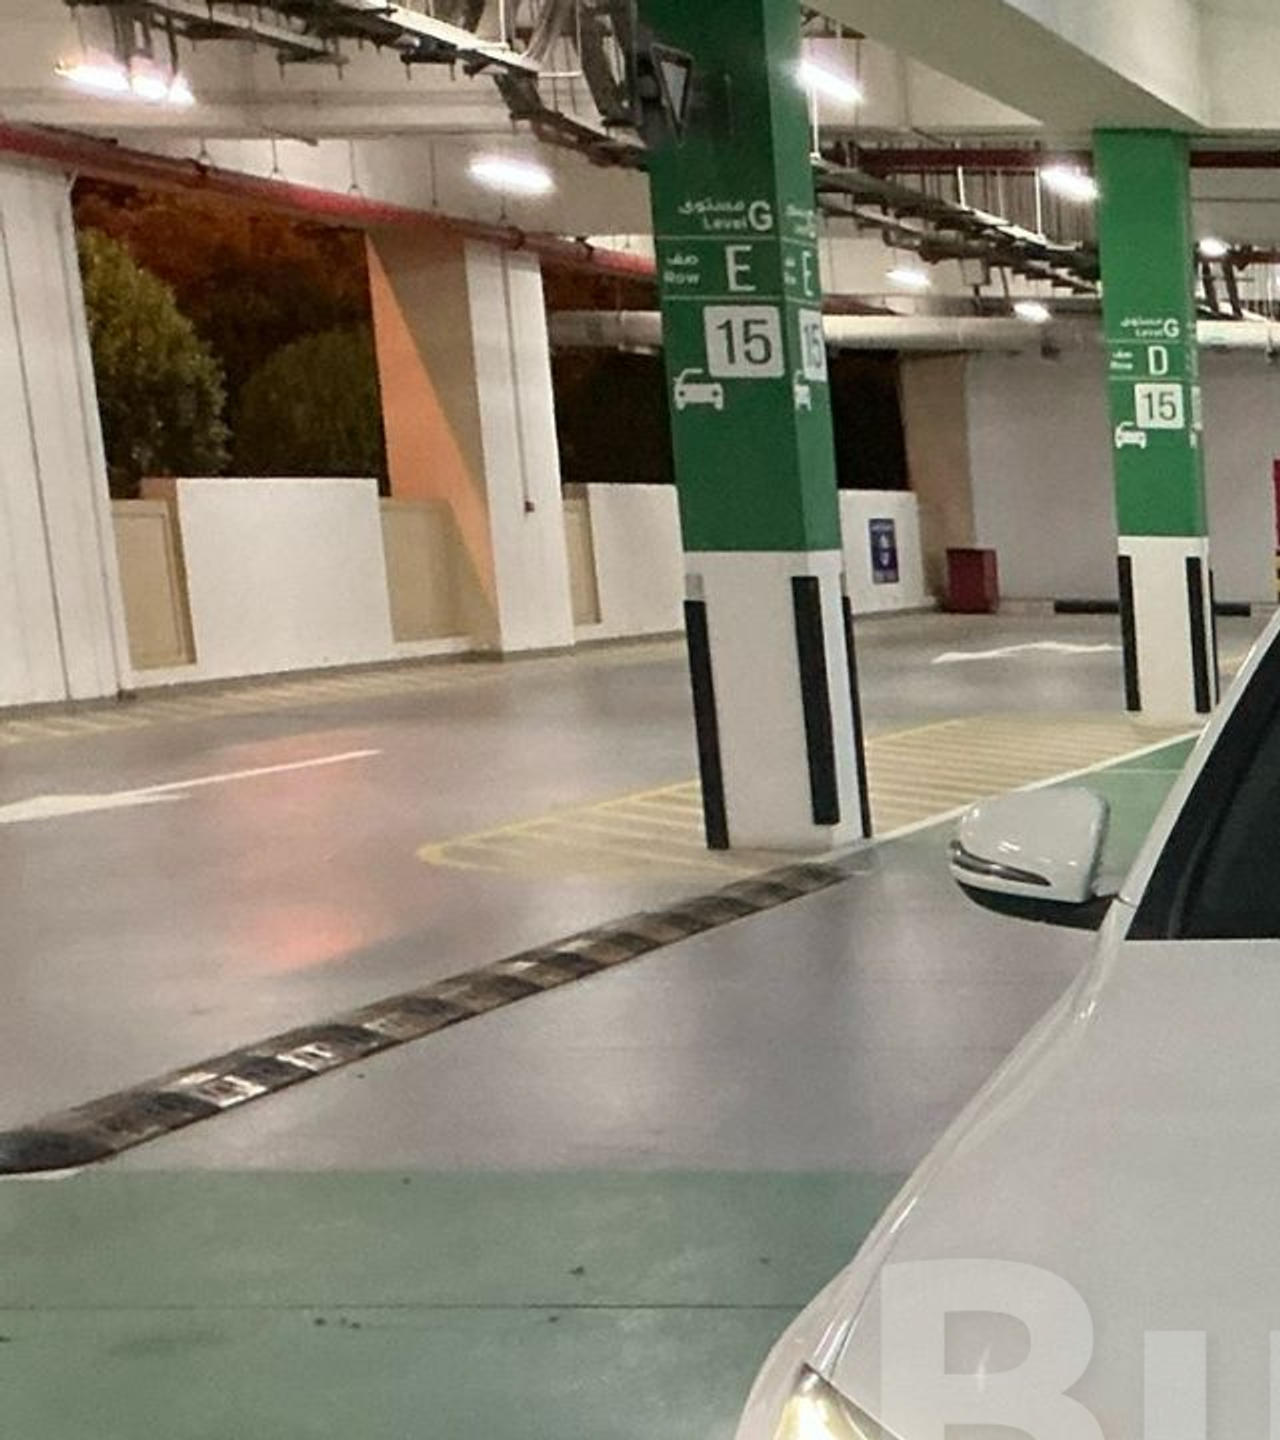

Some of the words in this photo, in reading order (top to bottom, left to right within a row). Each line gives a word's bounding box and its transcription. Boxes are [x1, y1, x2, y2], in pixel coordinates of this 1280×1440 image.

[703, 215, 747, 230] Level
[748, 200, 774, 231] G
[664, 271, 700, 284] Row
[725, 244, 756, 291] E
[716, 319, 772, 365] 15
[1164, 318, 1180, 338] G
[1148, 346, 1169, 376] D
[1142, 392, 1177, 421] 15
